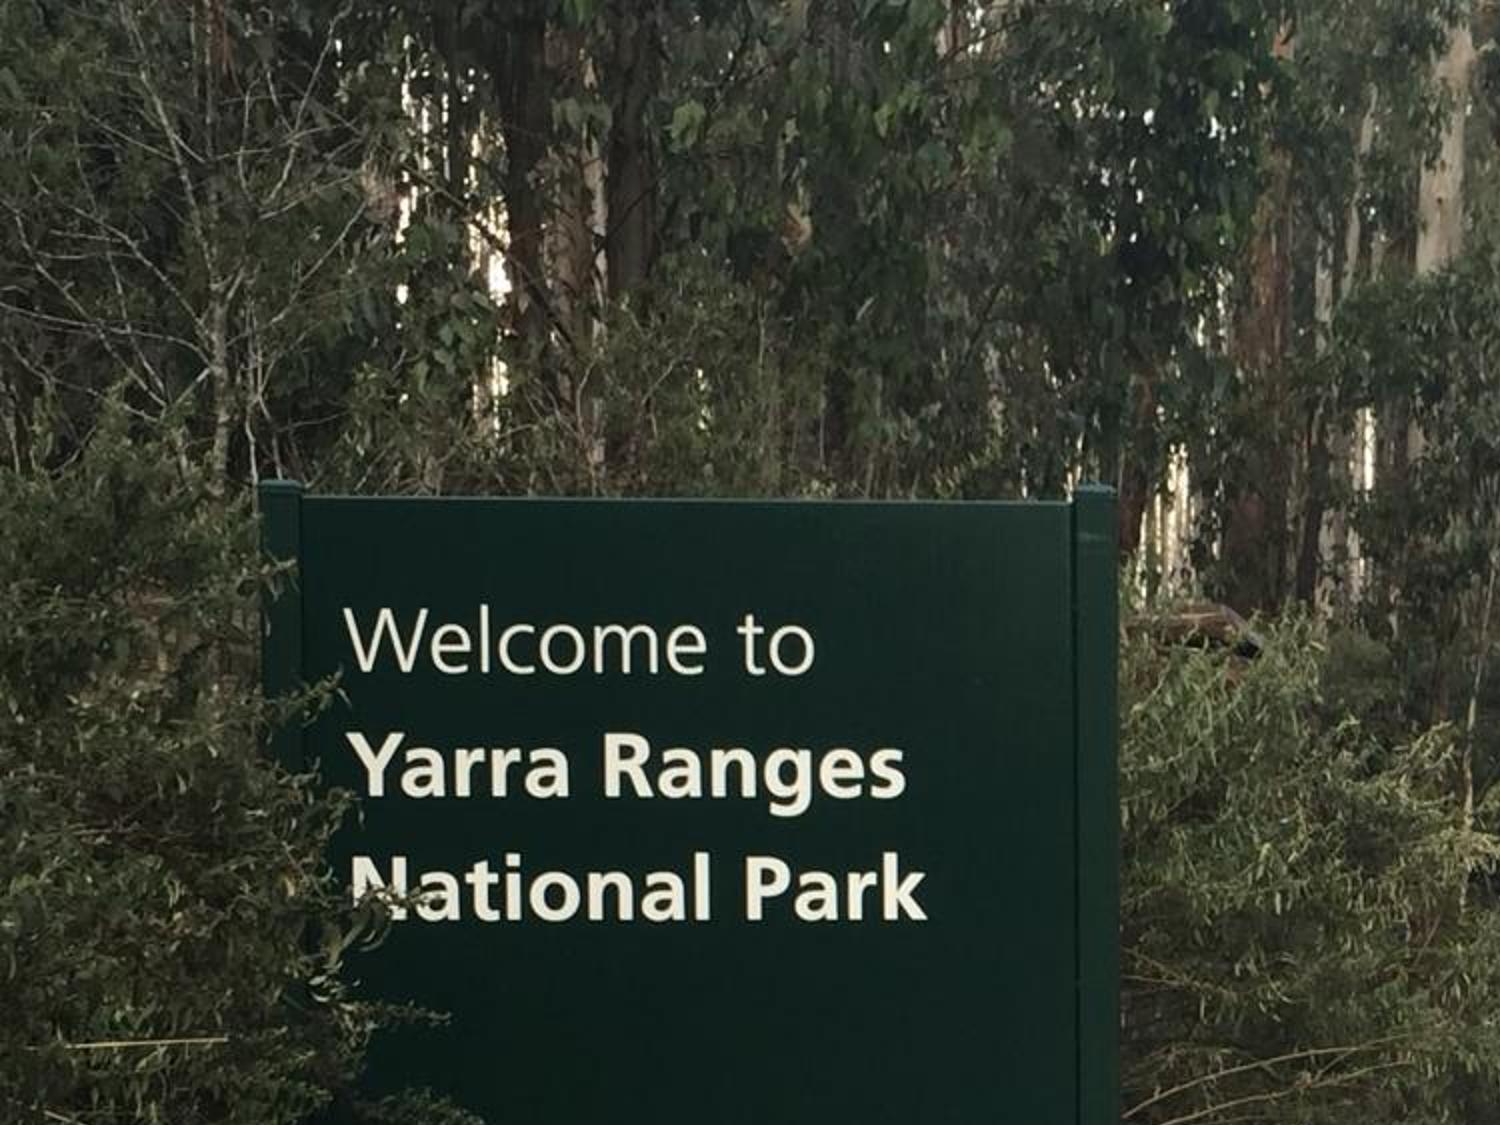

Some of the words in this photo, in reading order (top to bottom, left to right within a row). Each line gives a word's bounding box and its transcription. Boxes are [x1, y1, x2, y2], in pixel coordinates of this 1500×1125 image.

[343, 604, 707, 676] Welcome
[736, 613, 816, 676] to
[346, 732, 570, 798] Yarra
[603, 732, 906, 817] Ranges
[351, 852, 710, 922] National
[744, 852, 928, 922] Park
